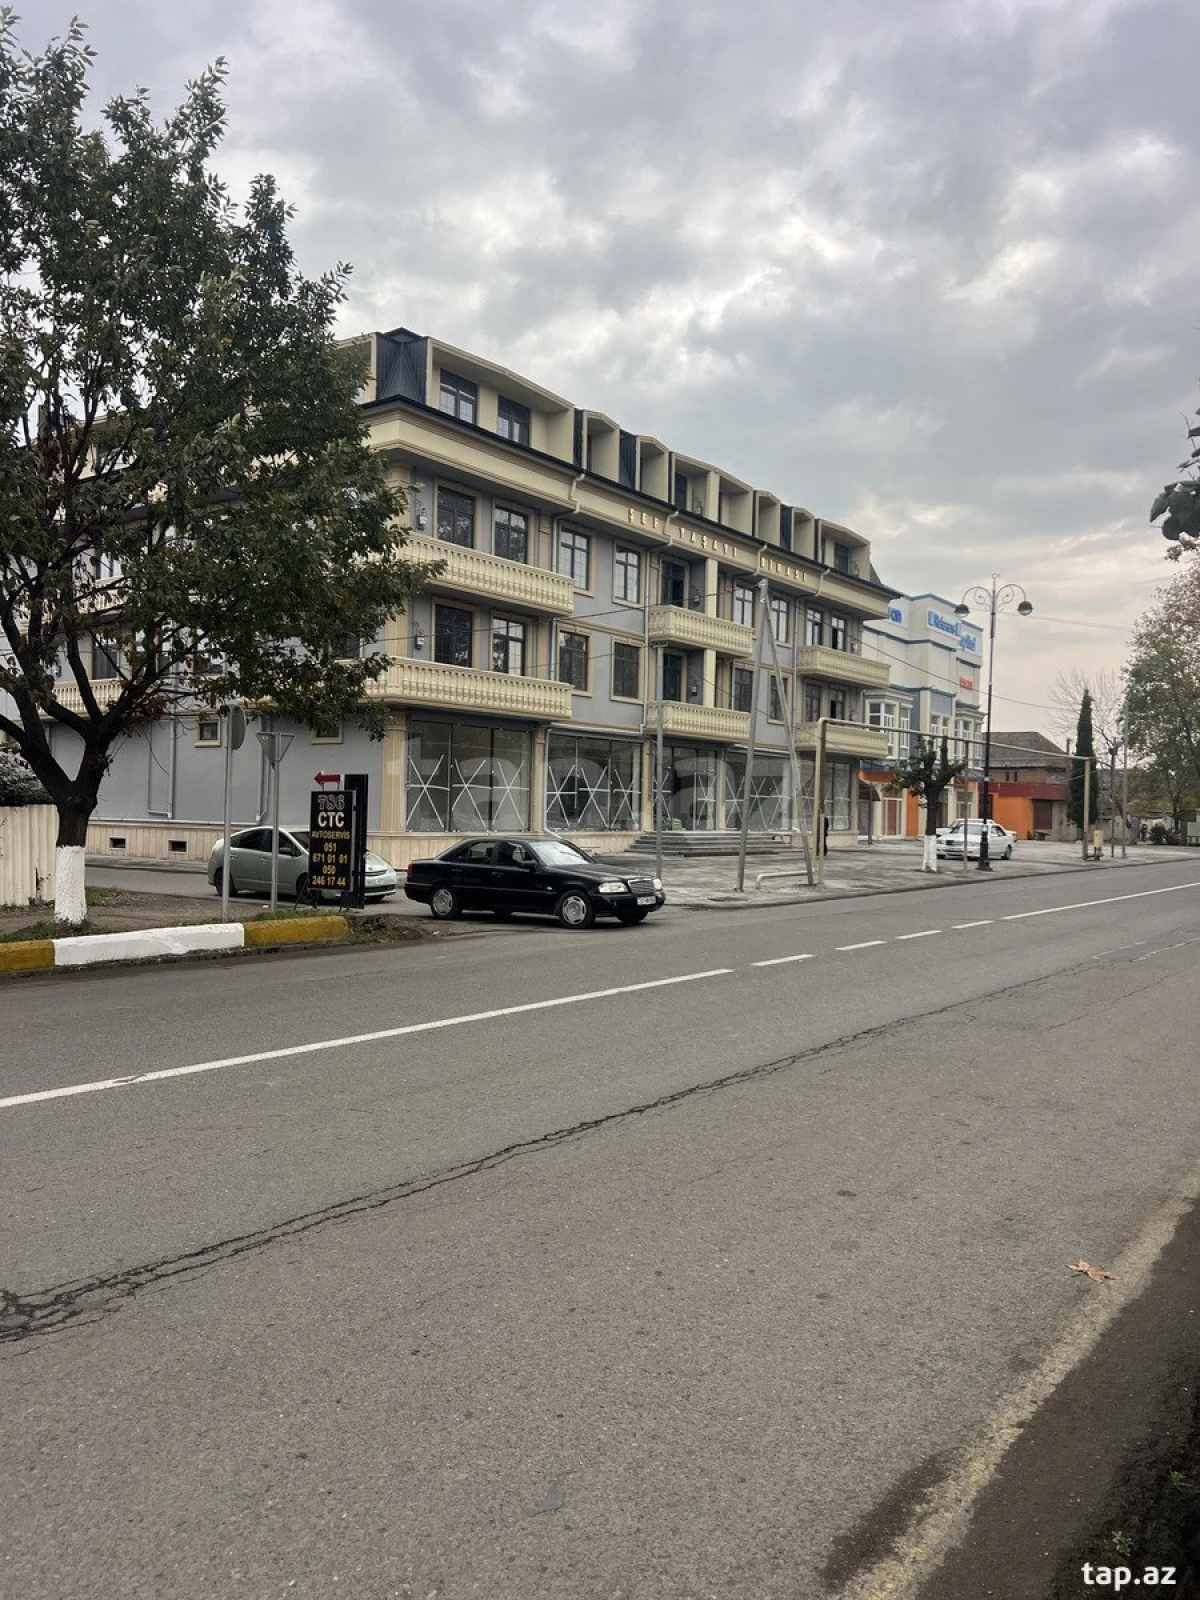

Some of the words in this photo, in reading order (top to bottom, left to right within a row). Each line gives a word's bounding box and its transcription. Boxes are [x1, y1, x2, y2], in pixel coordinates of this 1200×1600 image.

[318, 811, 345, 828] CTC
[324, 842, 337, 852] 051
[327, 853, 336, 864] 01
[339, 854, 348, 864] 01
[323, 865, 337, 875] 050
